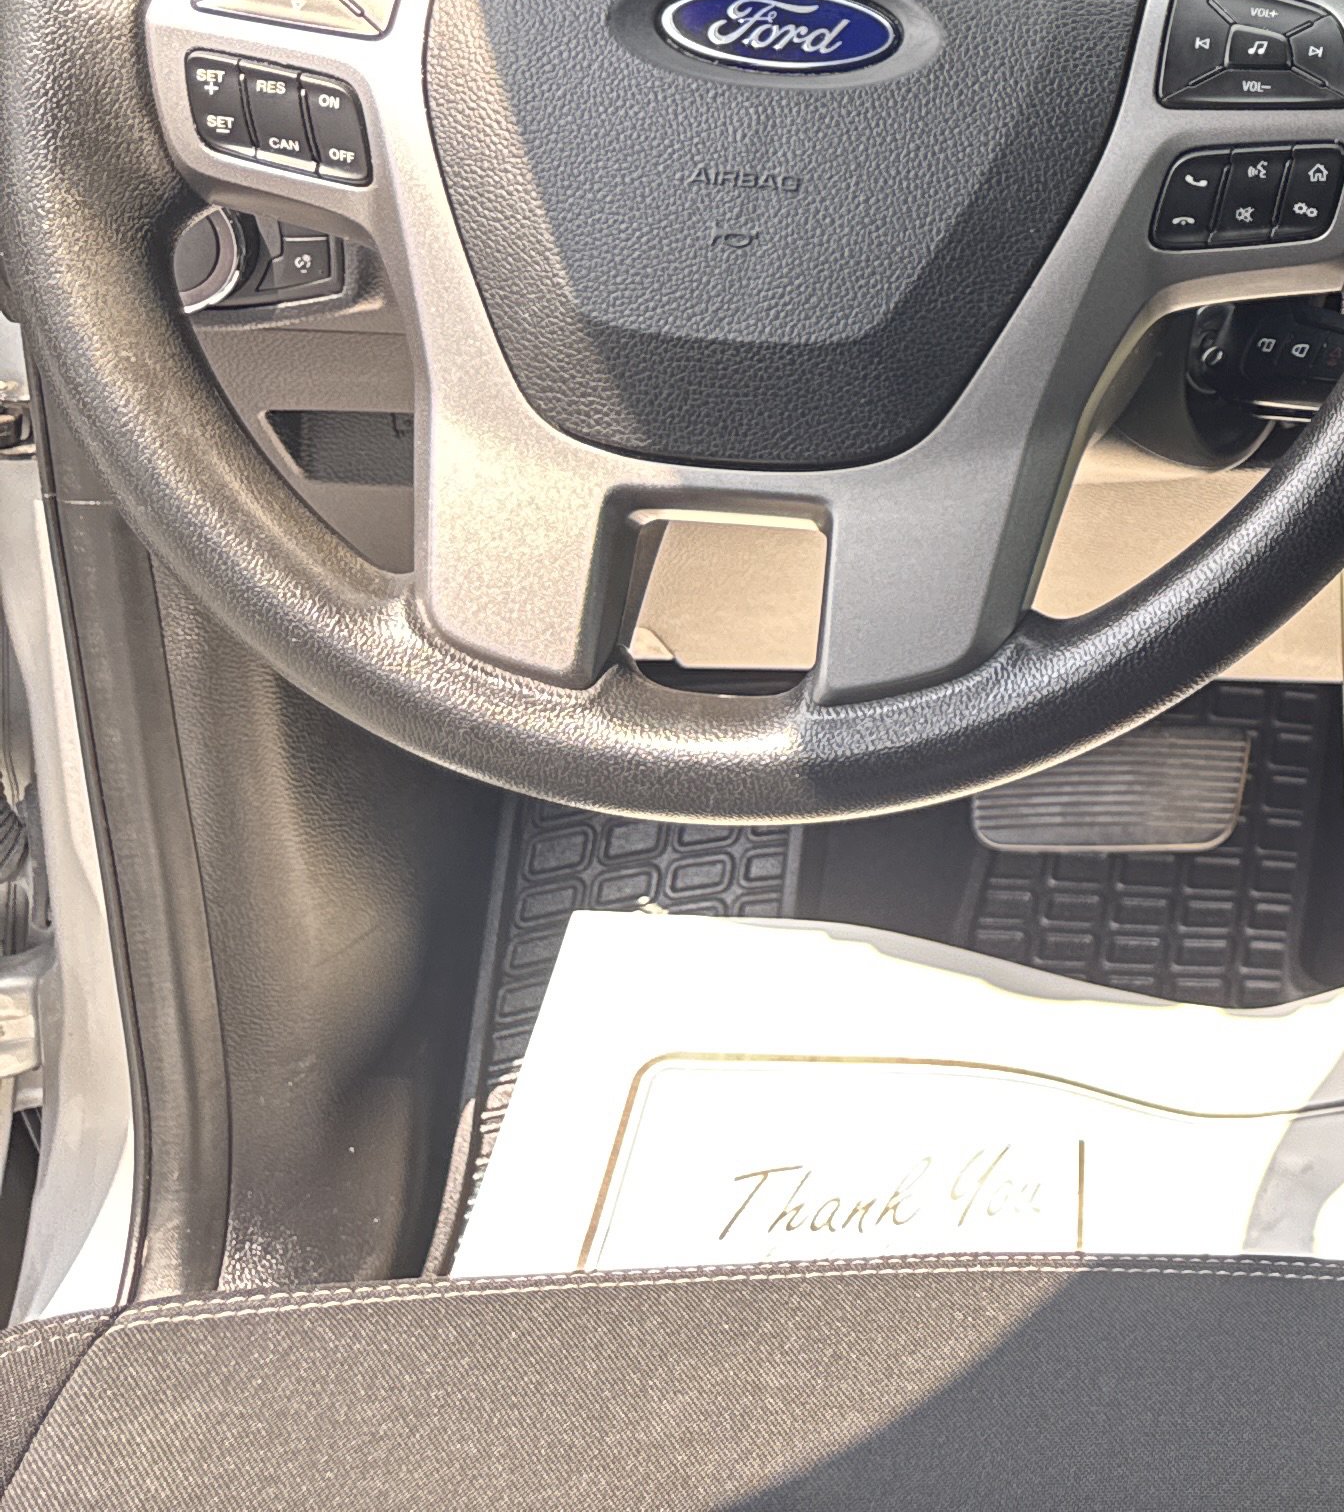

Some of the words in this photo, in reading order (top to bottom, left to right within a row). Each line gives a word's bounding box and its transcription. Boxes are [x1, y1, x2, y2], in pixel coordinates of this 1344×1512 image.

[256, 80, 286, 94] RES
[318, 94, 340, 109] ON
[269, 137, 299, 151] CAN
[329, 148, 355, 163] OFF
[690, 167, 801, 192] AIRBAG
[719, 1156, 932, 1241] Thank
[950, 1143, 1041, 1228] You
